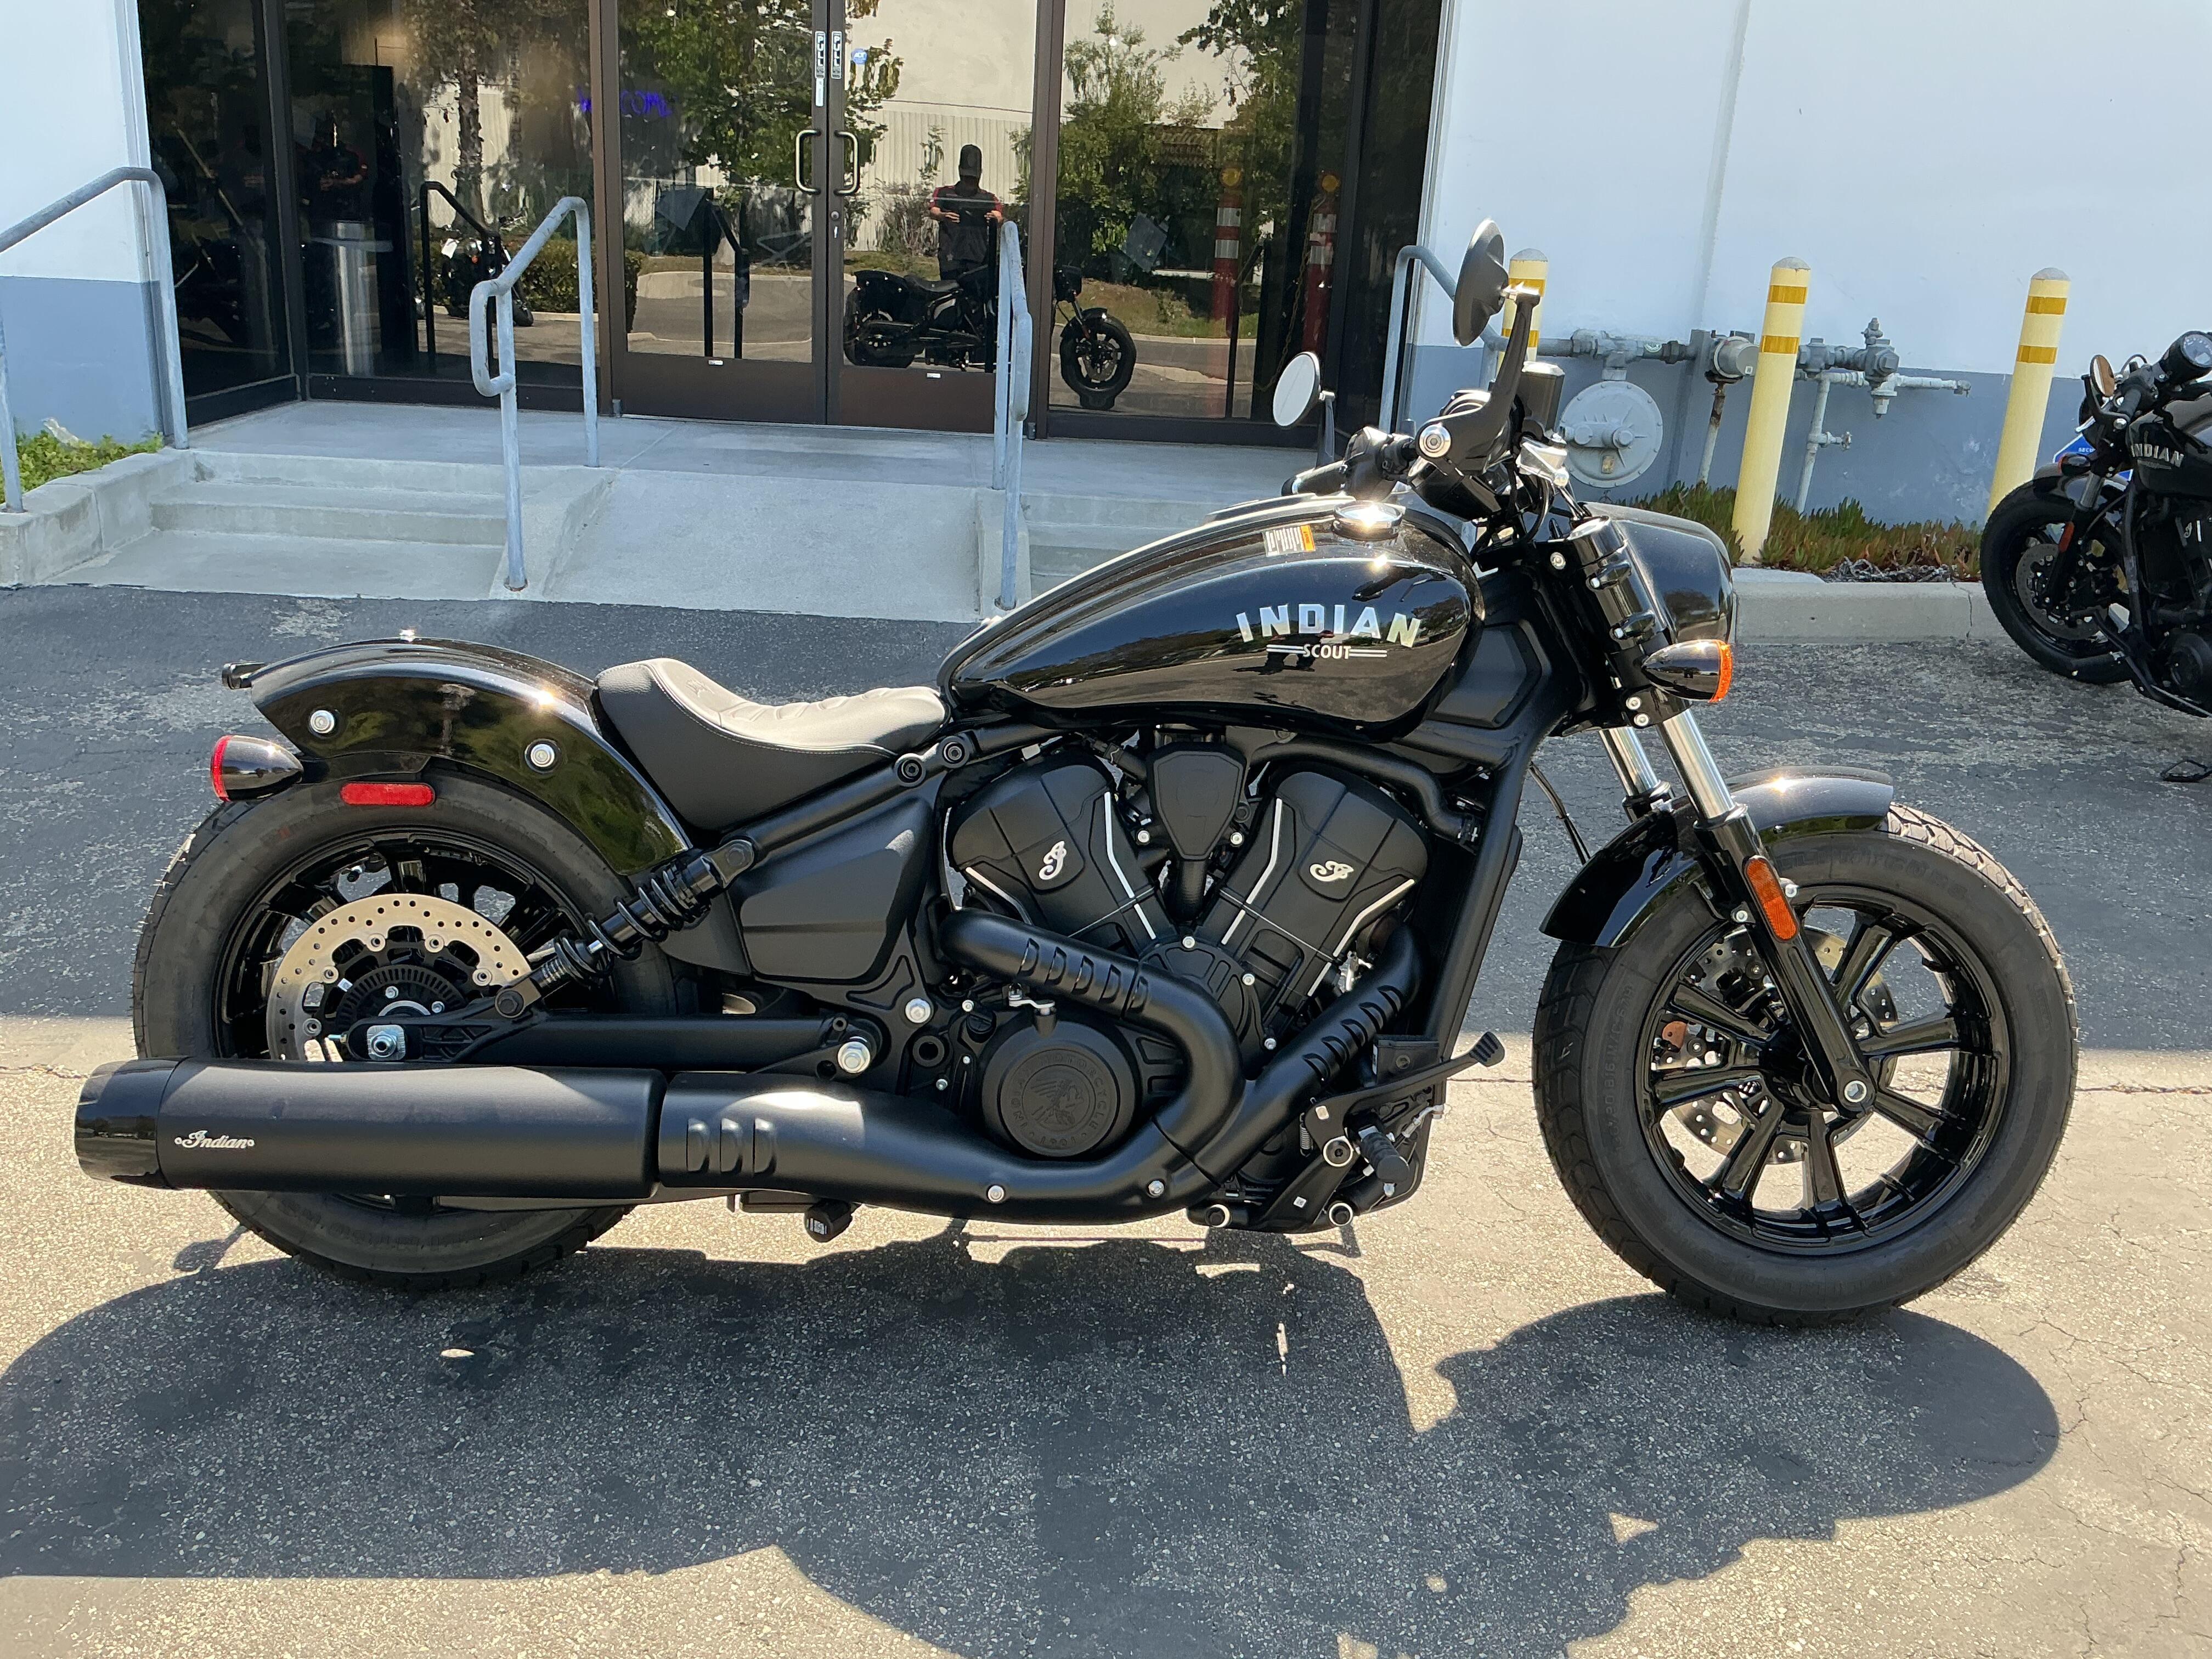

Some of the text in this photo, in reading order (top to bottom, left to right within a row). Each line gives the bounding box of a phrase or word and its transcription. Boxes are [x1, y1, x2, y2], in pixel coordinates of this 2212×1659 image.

[2131, 443, 2184, 468] INDIAN
[1235, 603, 1421, 648] INDIAN
[1303, 643, 1351, 660] SCOUT
[181, 1130, 249, 1149] Indian
